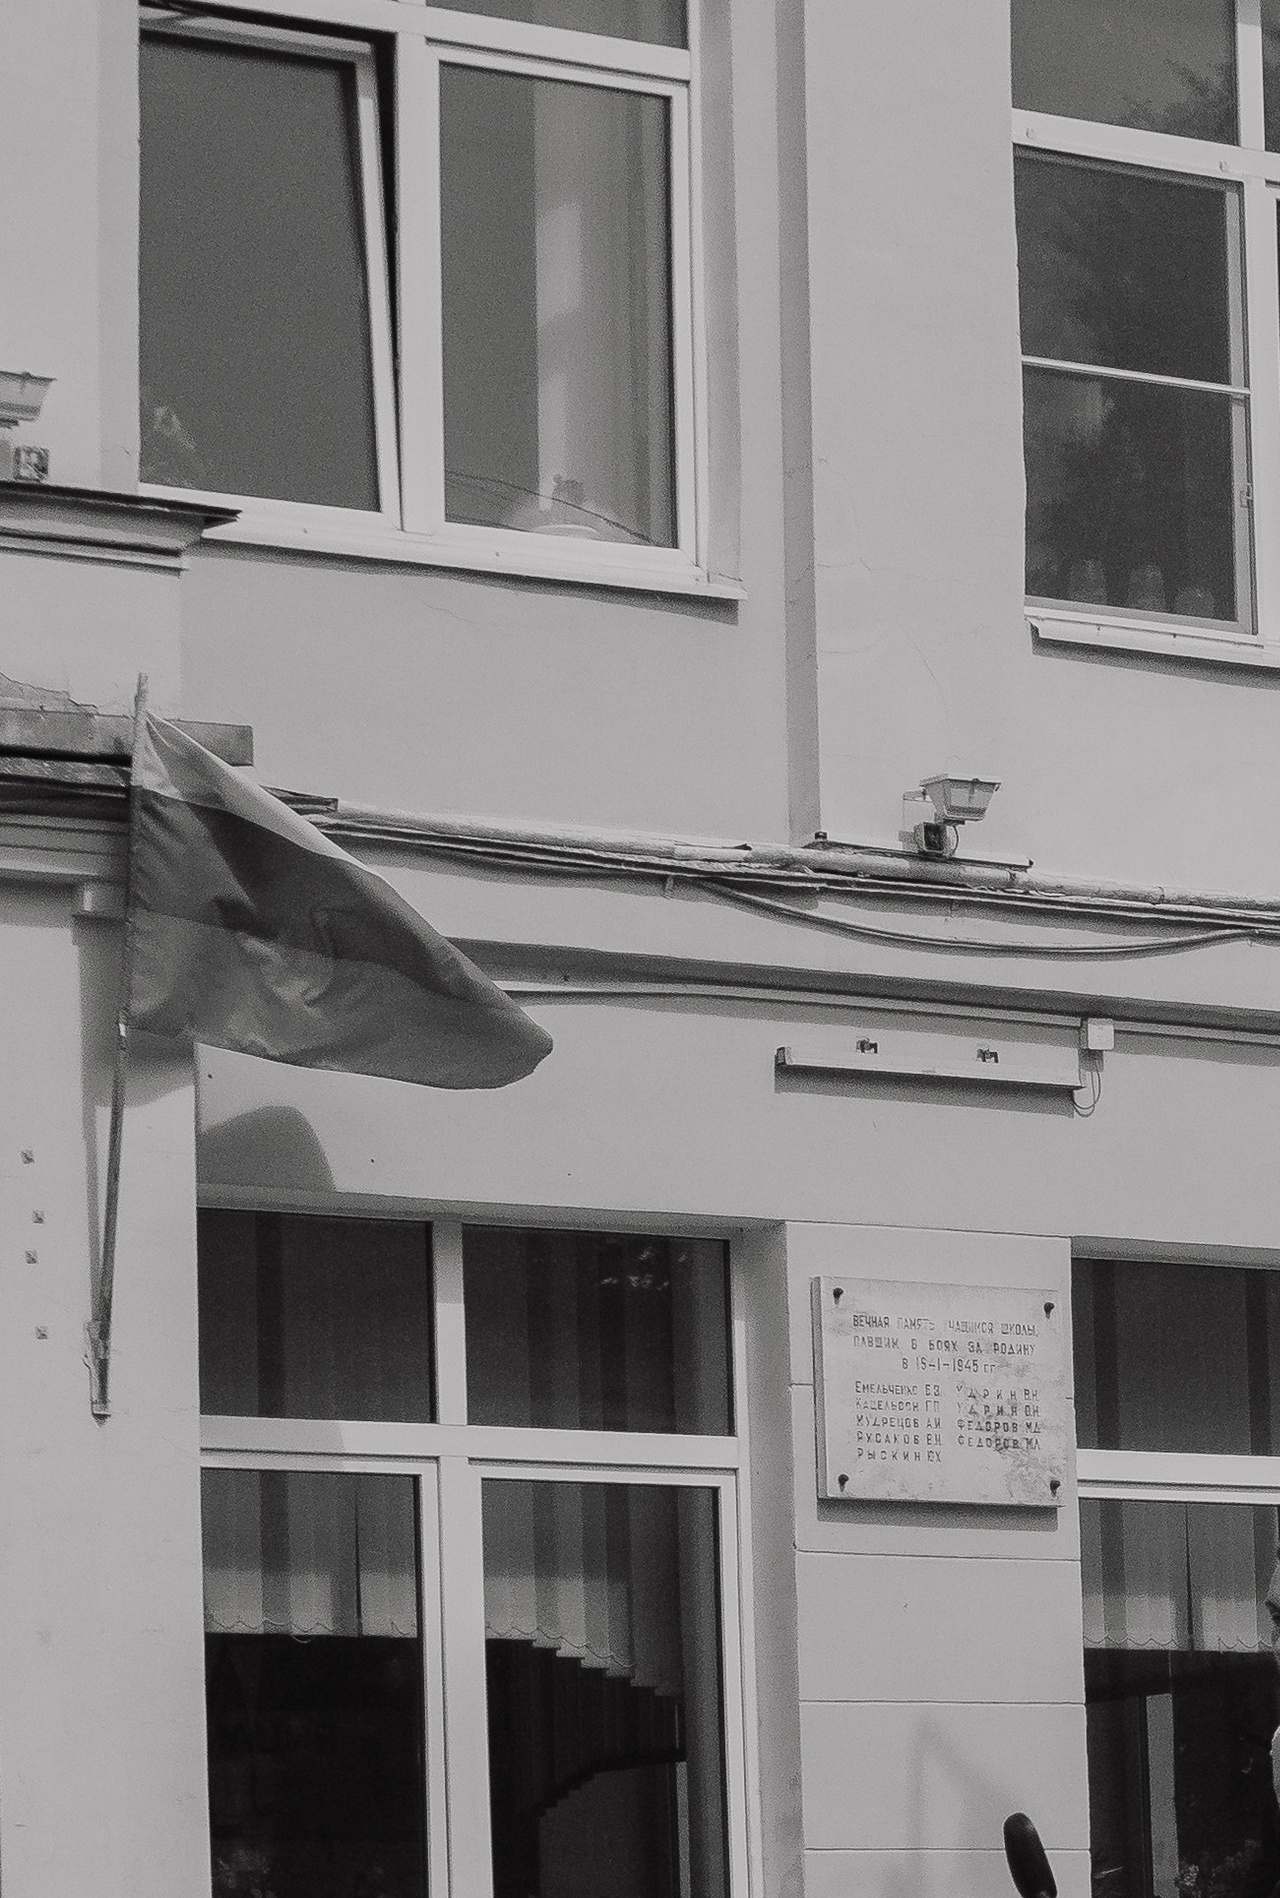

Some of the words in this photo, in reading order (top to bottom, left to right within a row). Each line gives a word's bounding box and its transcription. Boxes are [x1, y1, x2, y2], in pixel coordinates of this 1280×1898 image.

[853, 1314, 890, 1328] ВЕЧНАЯ
[853, 1335, 900, 1349] ПАВШИМ
[911, 1338, 918, 1350] В
[929, 1340, 958, 1352] БОЯХ
[968, 1341, 983, 1354] ЗА
[993, 1342, 1036, 1356] РОДИНУ
[902, 1357, 909, 1370] В
[957, 1419, 1018, 1432] ФЕДОРОВ
[856, 1430, 920, 1445] РУСАКОВ
[957, 1434, 1019, 1449] ФЕДОРОВ
[857, 1447, 921, 1462] РЫСКИН
